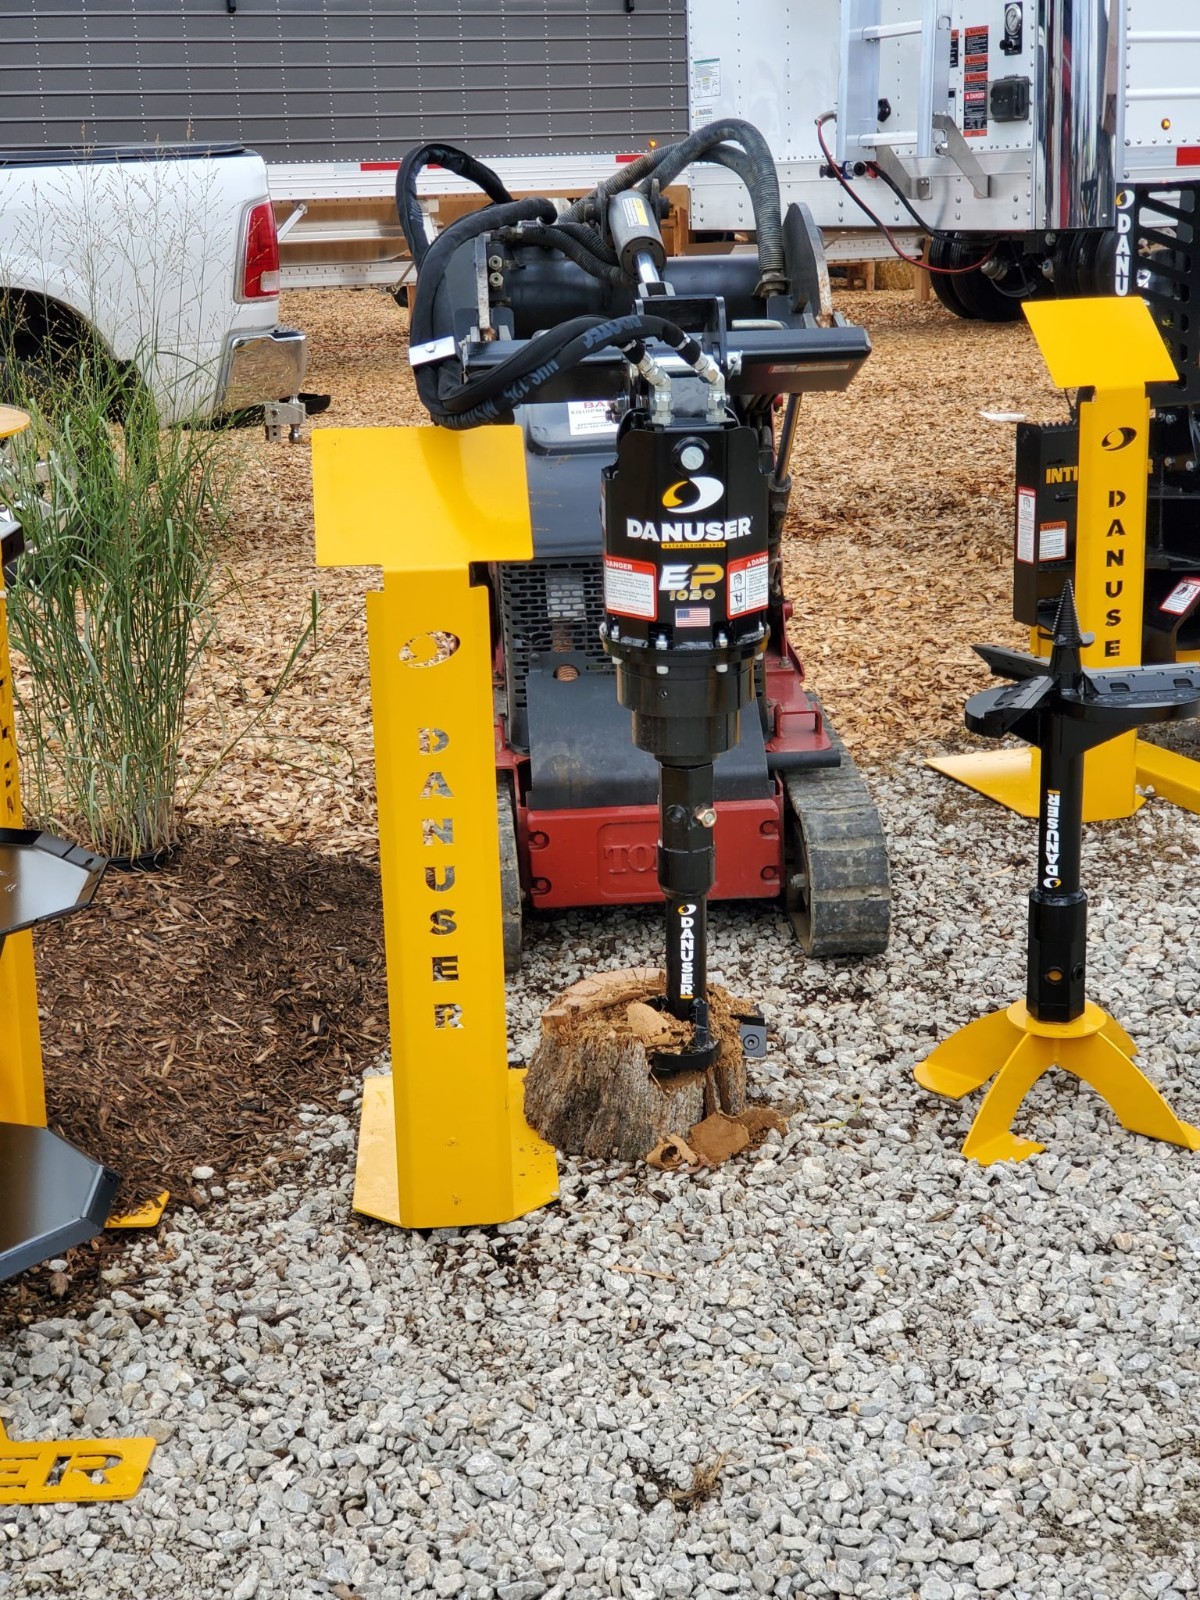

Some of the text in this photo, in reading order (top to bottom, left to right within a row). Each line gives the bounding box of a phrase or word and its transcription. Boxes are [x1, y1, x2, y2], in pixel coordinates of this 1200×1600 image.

[584, 401, 612, 409] BA
[626, 516, 752, 542] DANUSER
[605, 560, 633, 571] DANGER
[659, 564, 725, 591] EP
[1045, 794, 1061, 876] DANUSER
[603, 843, 658, 874] TO
[418, 727, 465, 1029] DANUSER
[680, 916, 695, 995] DANUSER
